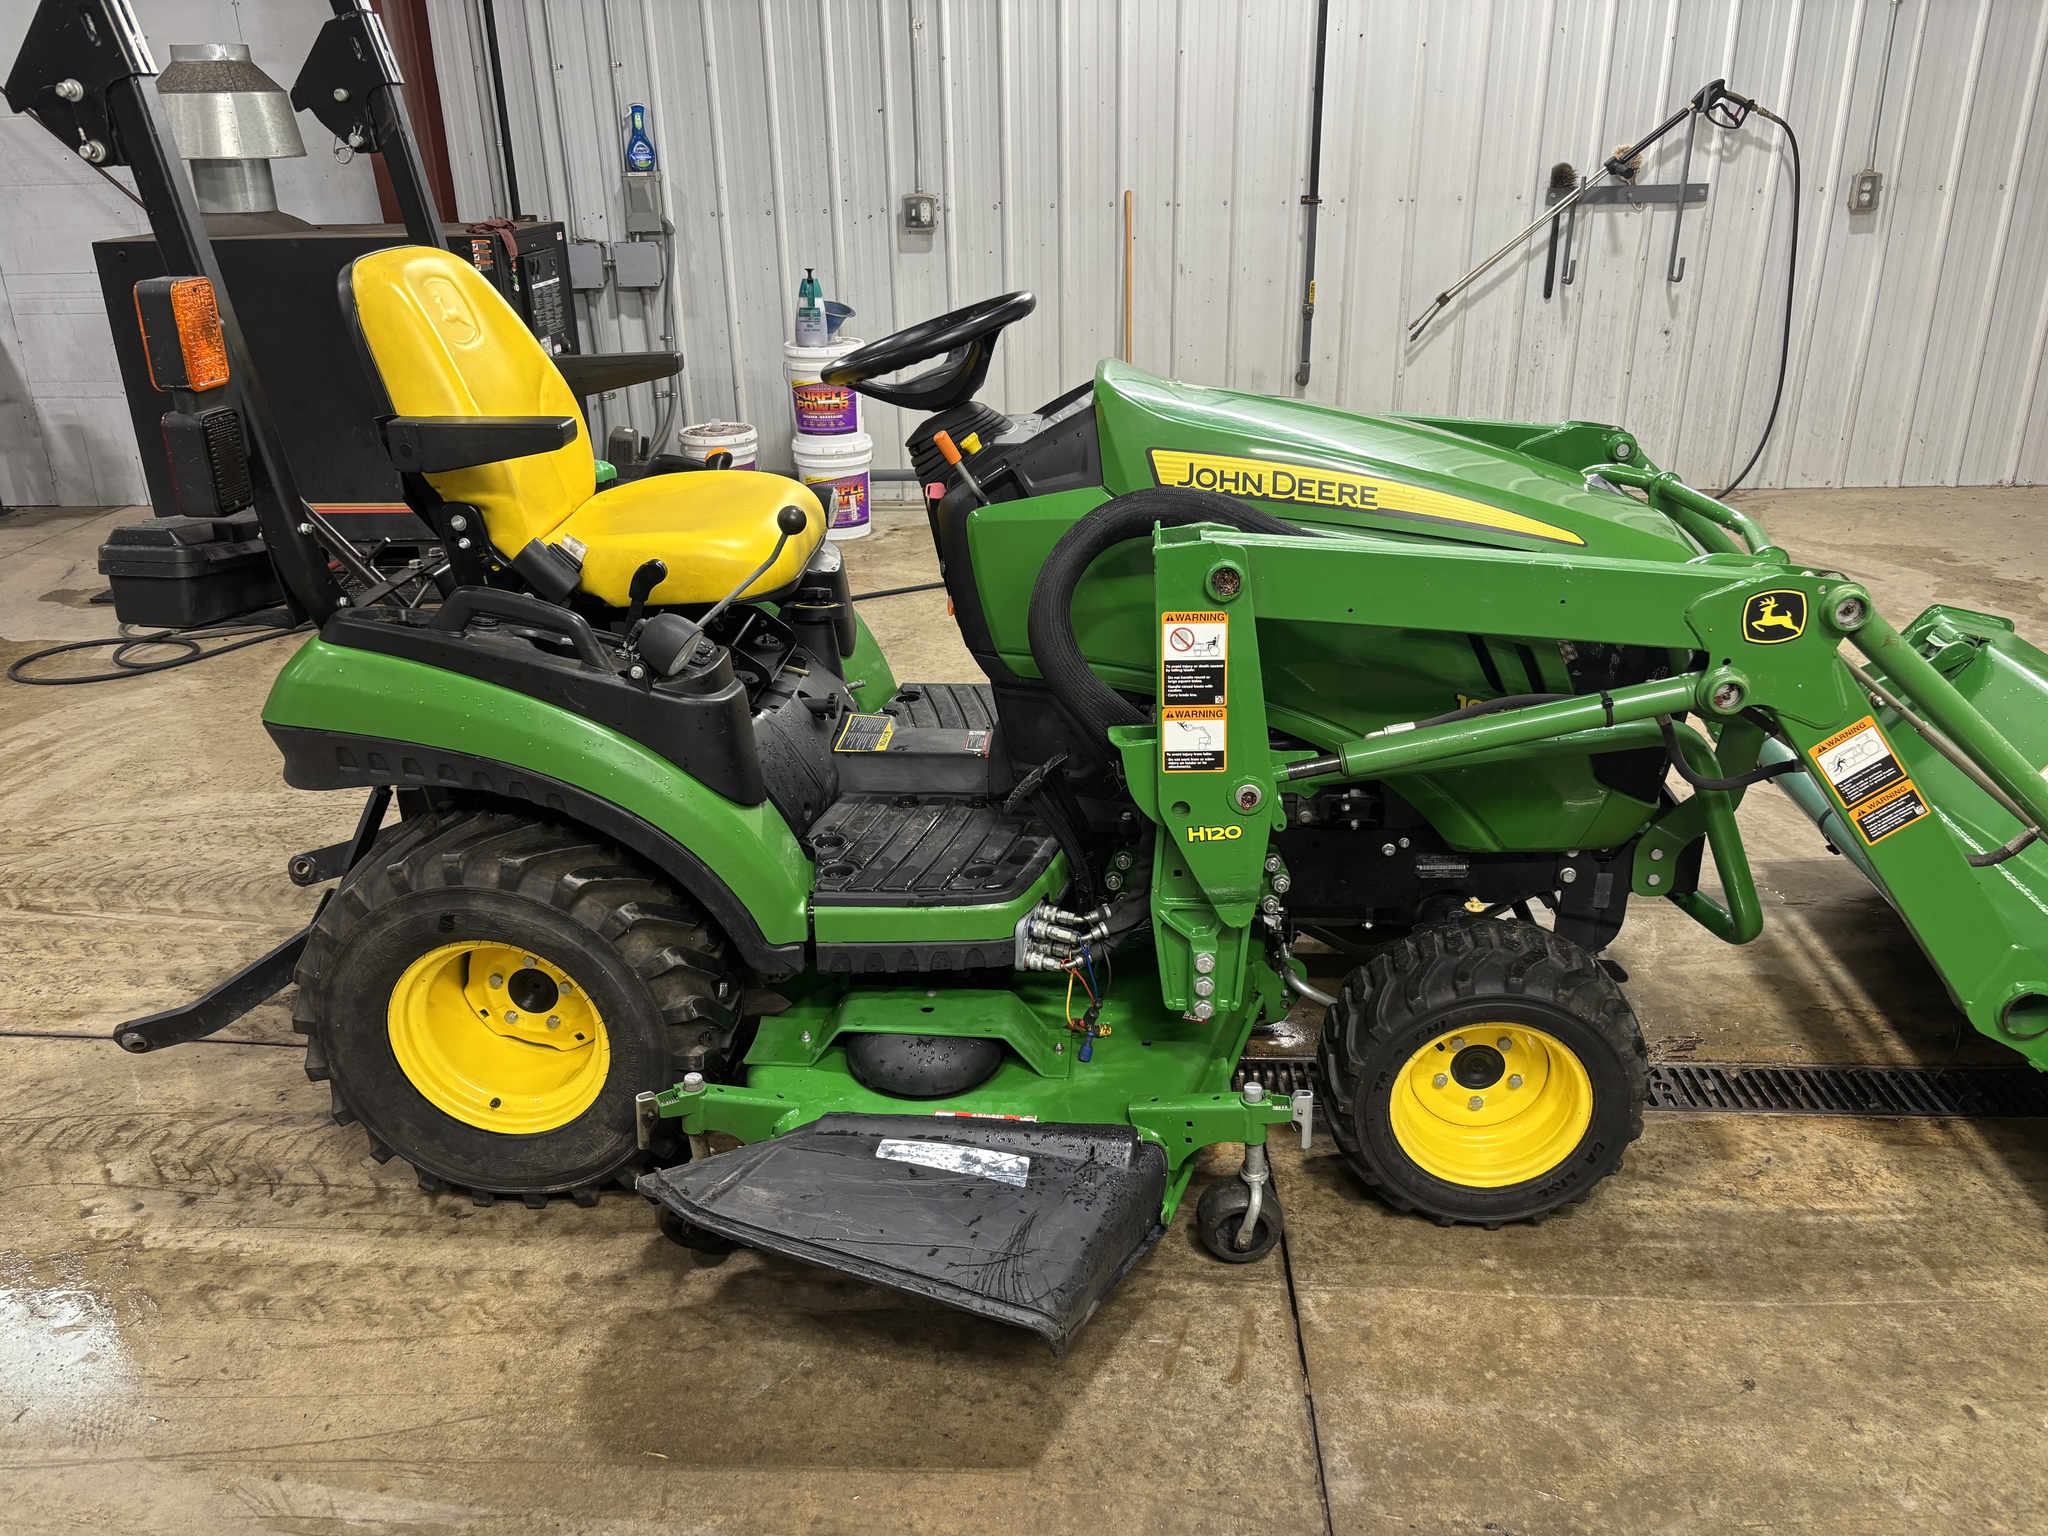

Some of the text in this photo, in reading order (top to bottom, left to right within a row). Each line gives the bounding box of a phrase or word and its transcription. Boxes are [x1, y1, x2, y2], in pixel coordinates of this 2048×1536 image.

[796, 389, 849, 401] PURPLE
[797, 400, 849, 411] POWER
[1177, 463, 1379, 507] JOHN DEERE
[1175, 613, 1225, 622] WARNING
[1175, 710, 1224, 718] WARNING
[1826, 722, 1867, 748] WARNING
[1867, 785, 1907, 810] WARNING
[1187, 825, 1243, 843] H120
